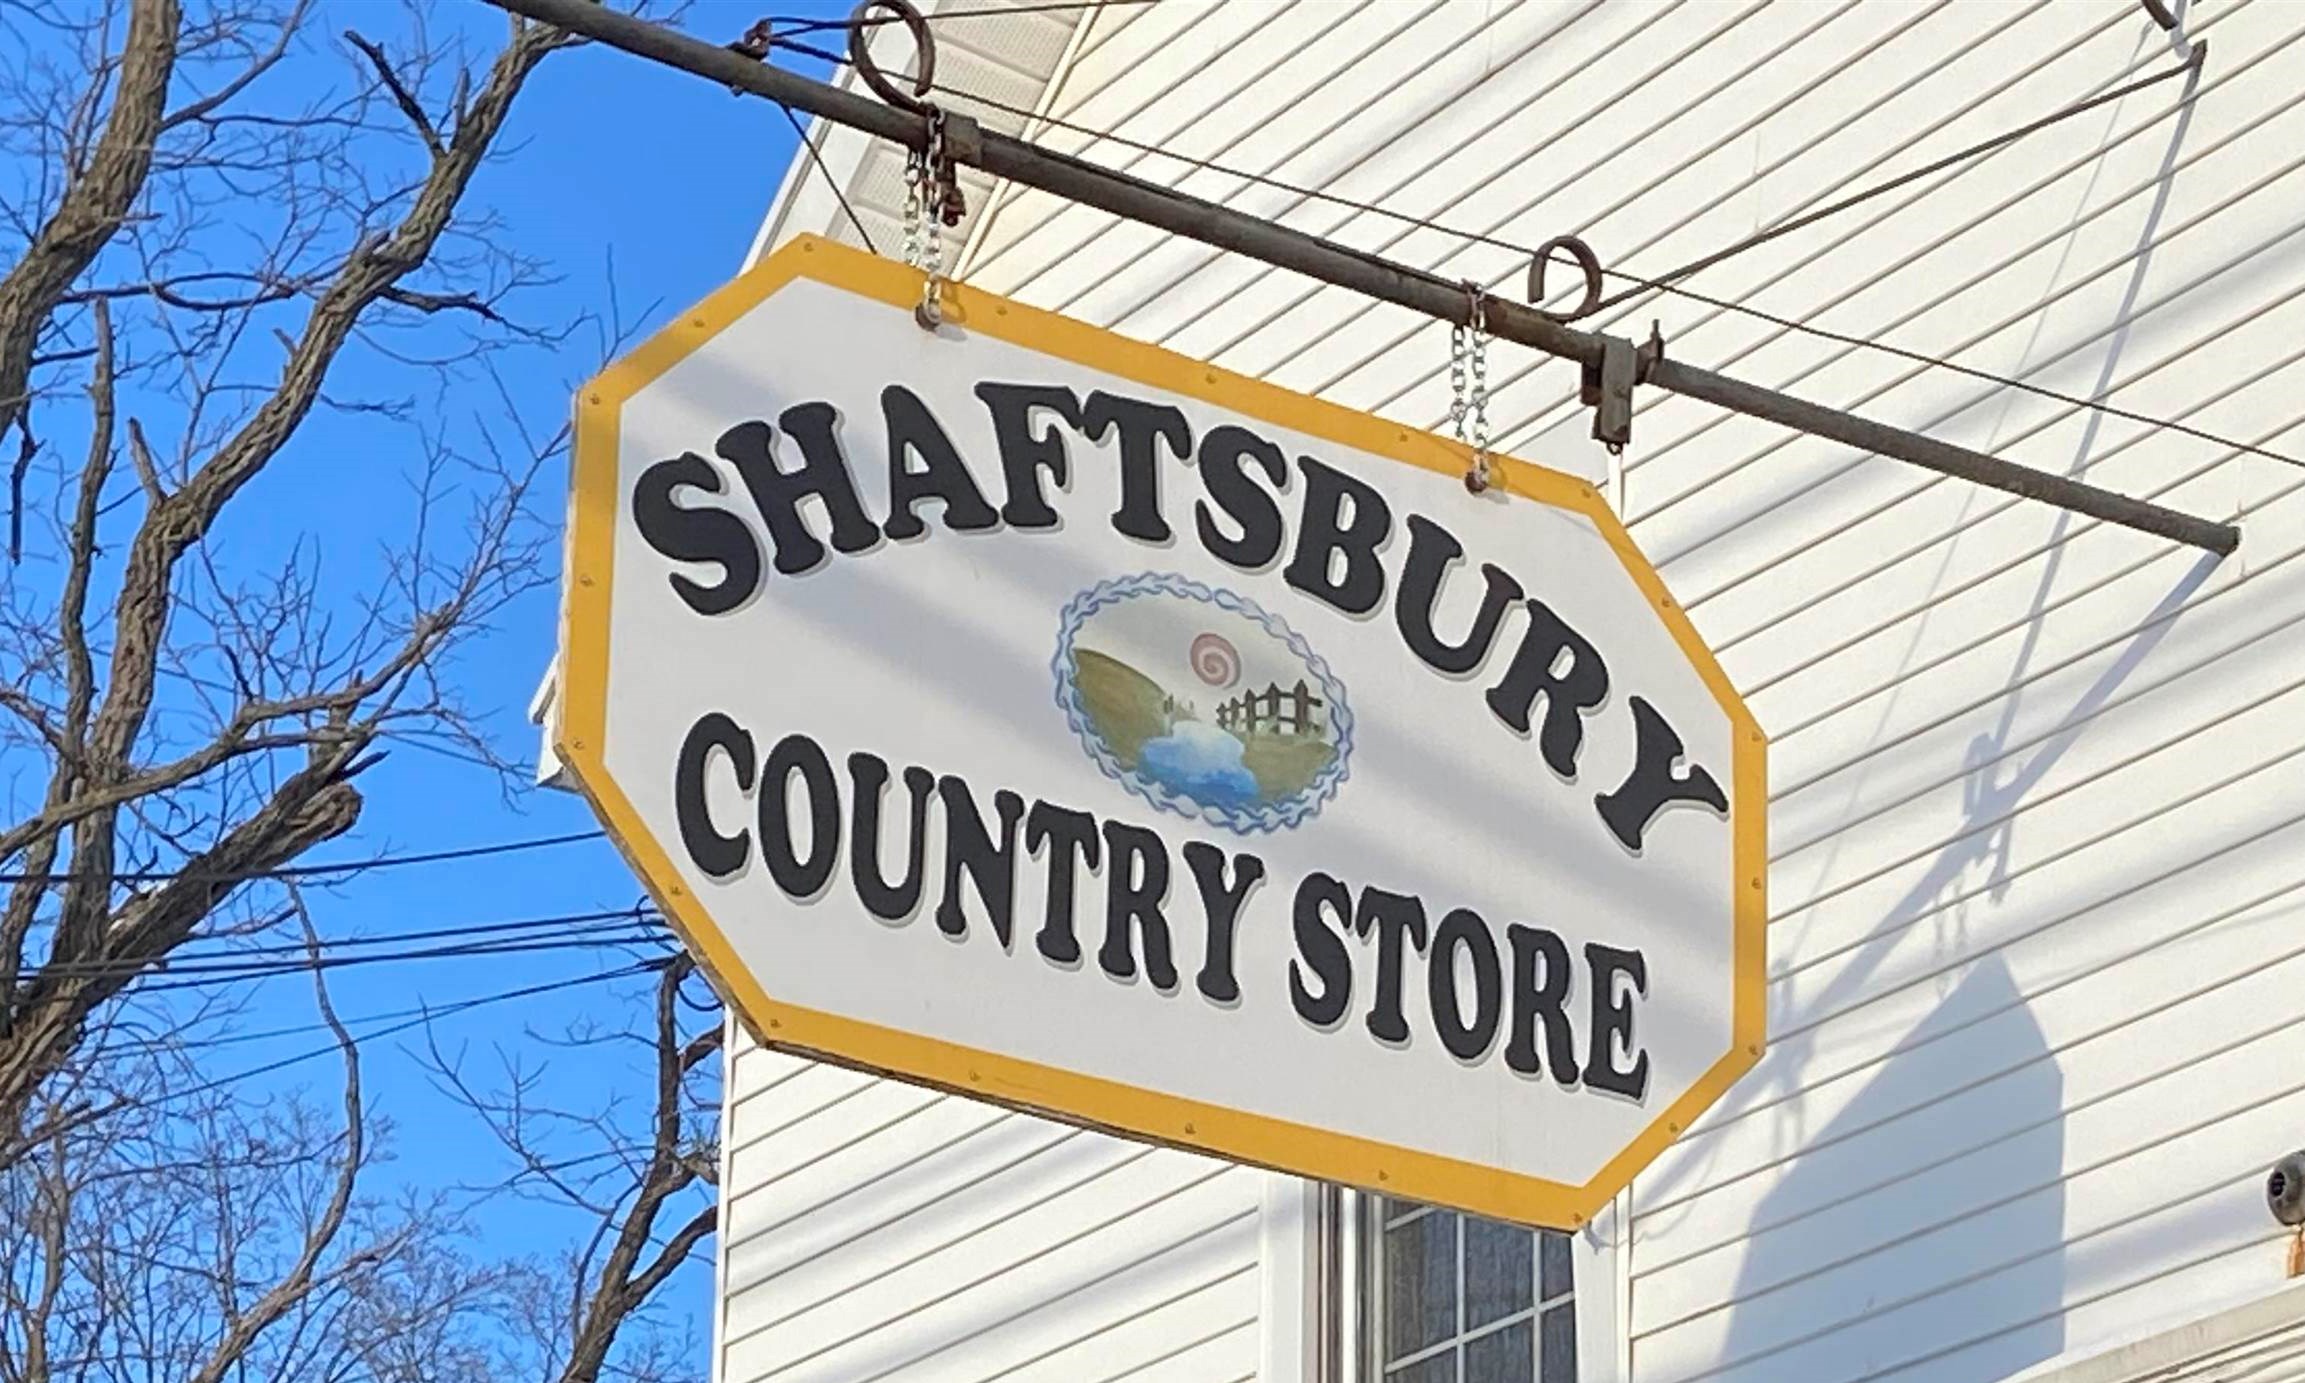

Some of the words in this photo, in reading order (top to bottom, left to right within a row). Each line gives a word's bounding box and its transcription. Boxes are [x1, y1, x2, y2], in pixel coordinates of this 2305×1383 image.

[633, 380, 1730, 852] SHAFTSBURY
[676, 712, 1265, 1002] COUNTRY
[1289, 872, 1650, 1101] STORE
